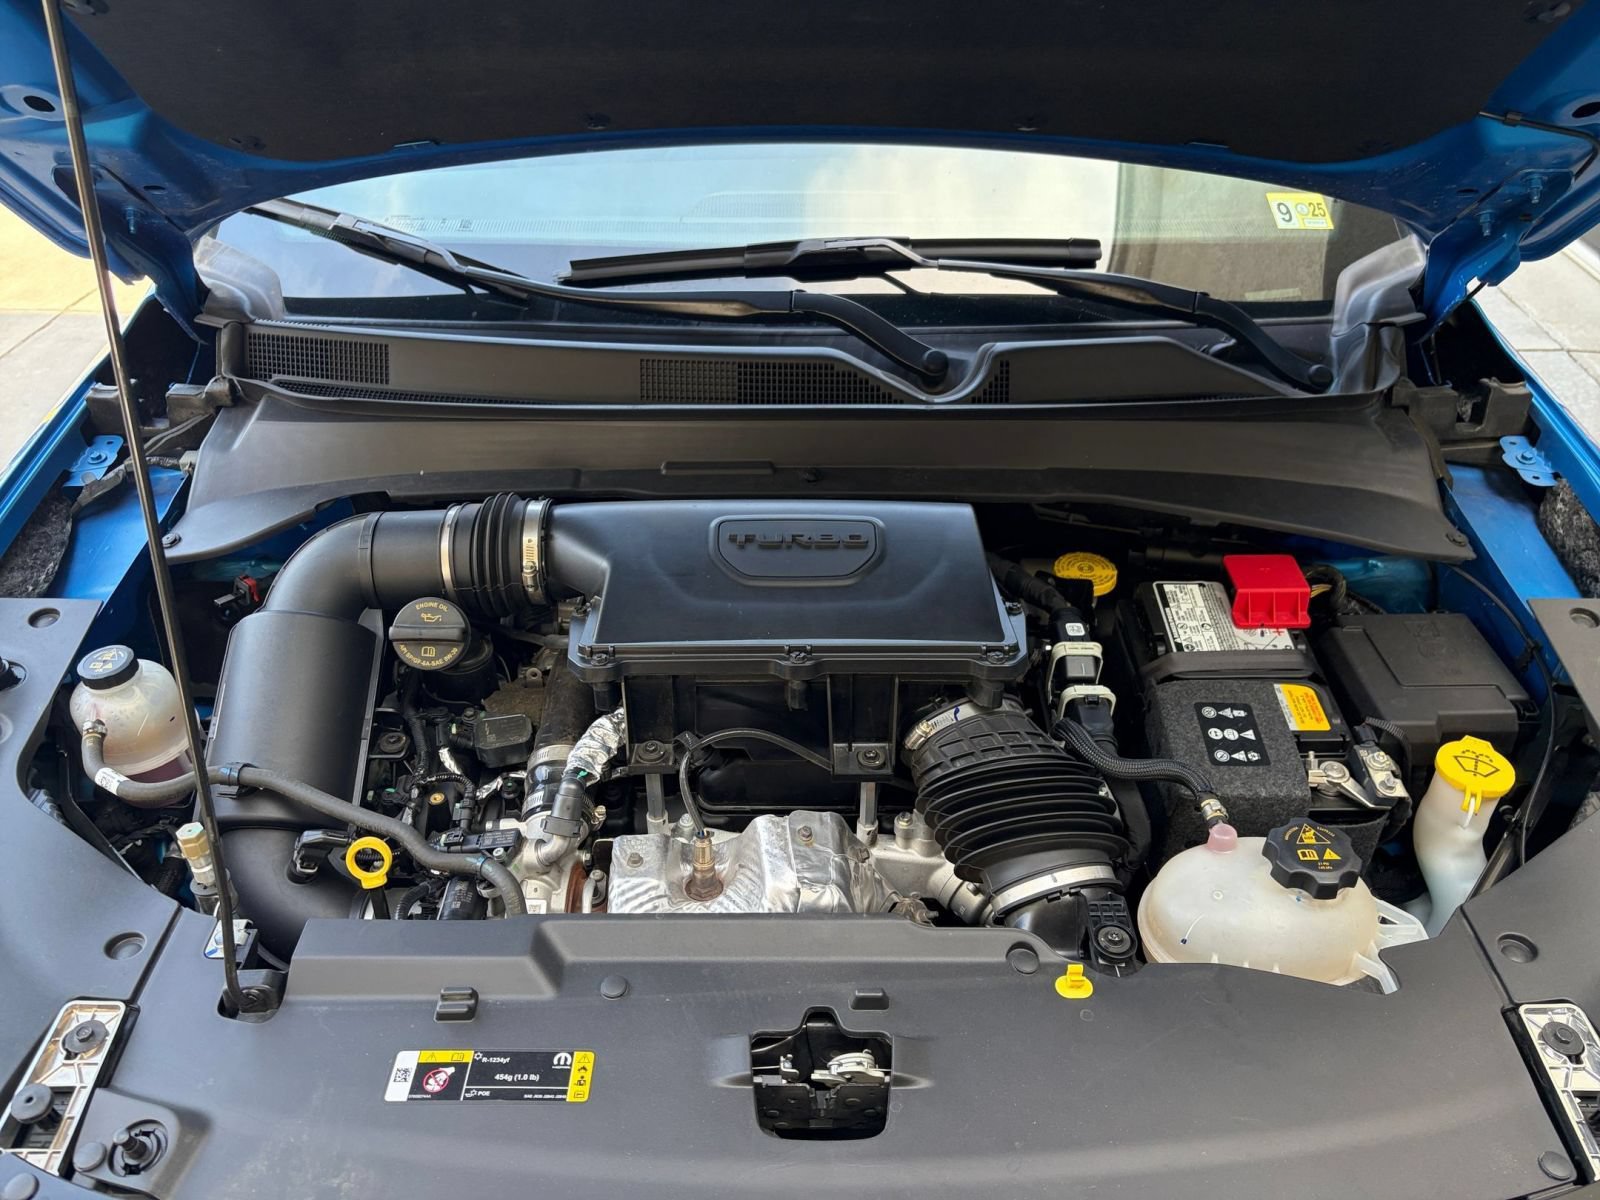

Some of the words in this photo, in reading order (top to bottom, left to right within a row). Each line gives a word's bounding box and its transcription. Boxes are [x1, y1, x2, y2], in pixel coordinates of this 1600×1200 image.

[1276, 202, 1292, 223] 9
[1308, 202, 1326, 217] 25
[728, 533, 869, 549] TURBO
[416, 602, 438, 610] ENGINE
[439, 604, 448, 612] OIL
[494, 1073, 514, 1082] 454g
[514, 1073, 528, 1082] (1.0
[529, 1073, 540, 1082] lb)
